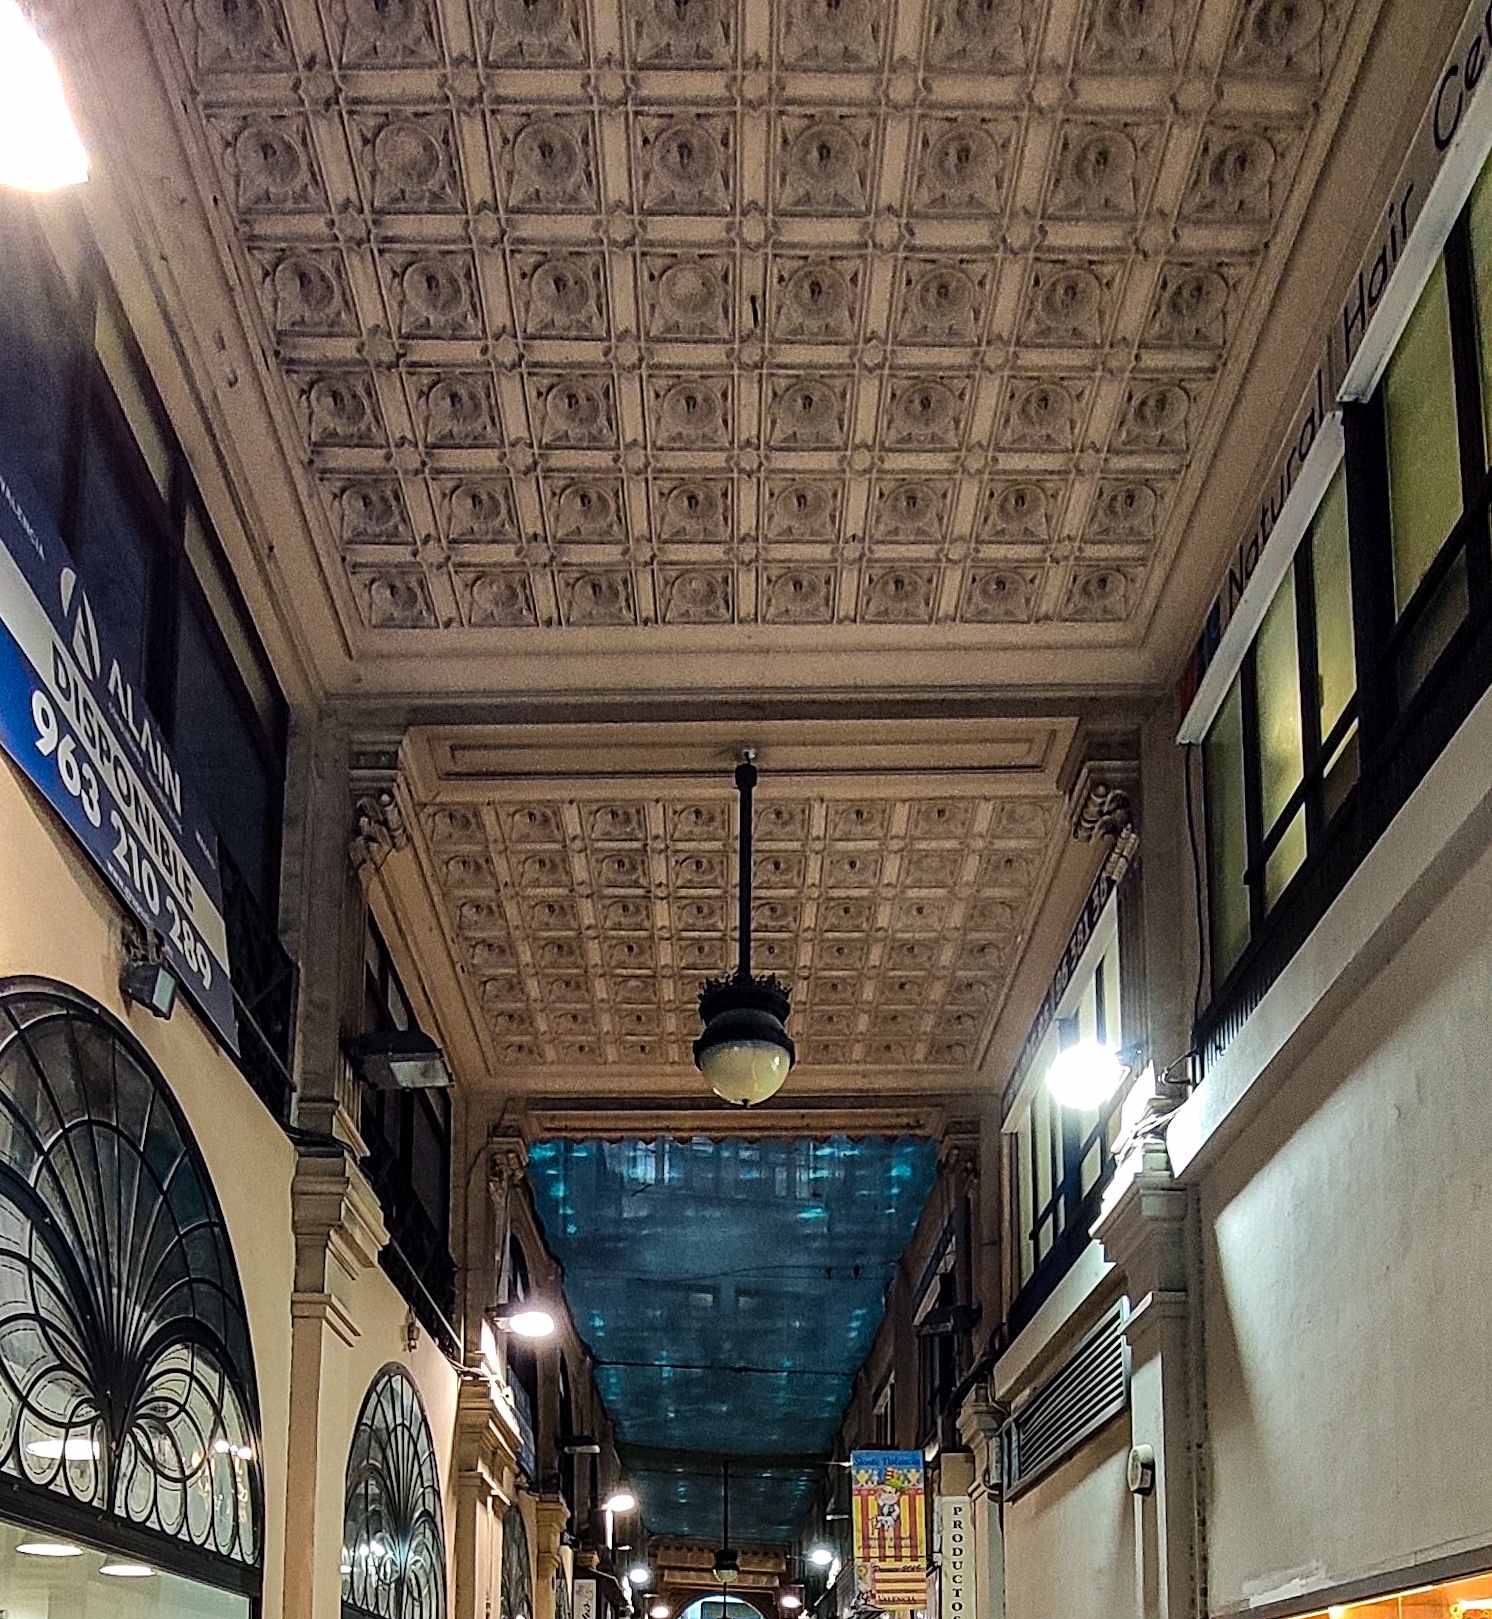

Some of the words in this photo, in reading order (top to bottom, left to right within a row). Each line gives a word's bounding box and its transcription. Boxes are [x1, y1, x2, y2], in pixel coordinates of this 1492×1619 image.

[1228, 367, 1324, 619] Natural
[1343, 182, 1415, 365] Hair
[31, 689, 102, 829] 963
[110, 809, 160, 917] 210
[165, 895, 213, 991] 289
[51, 638, 194, 914] DISPONIBLE
[107, 657, 182, 818] ALAIN
